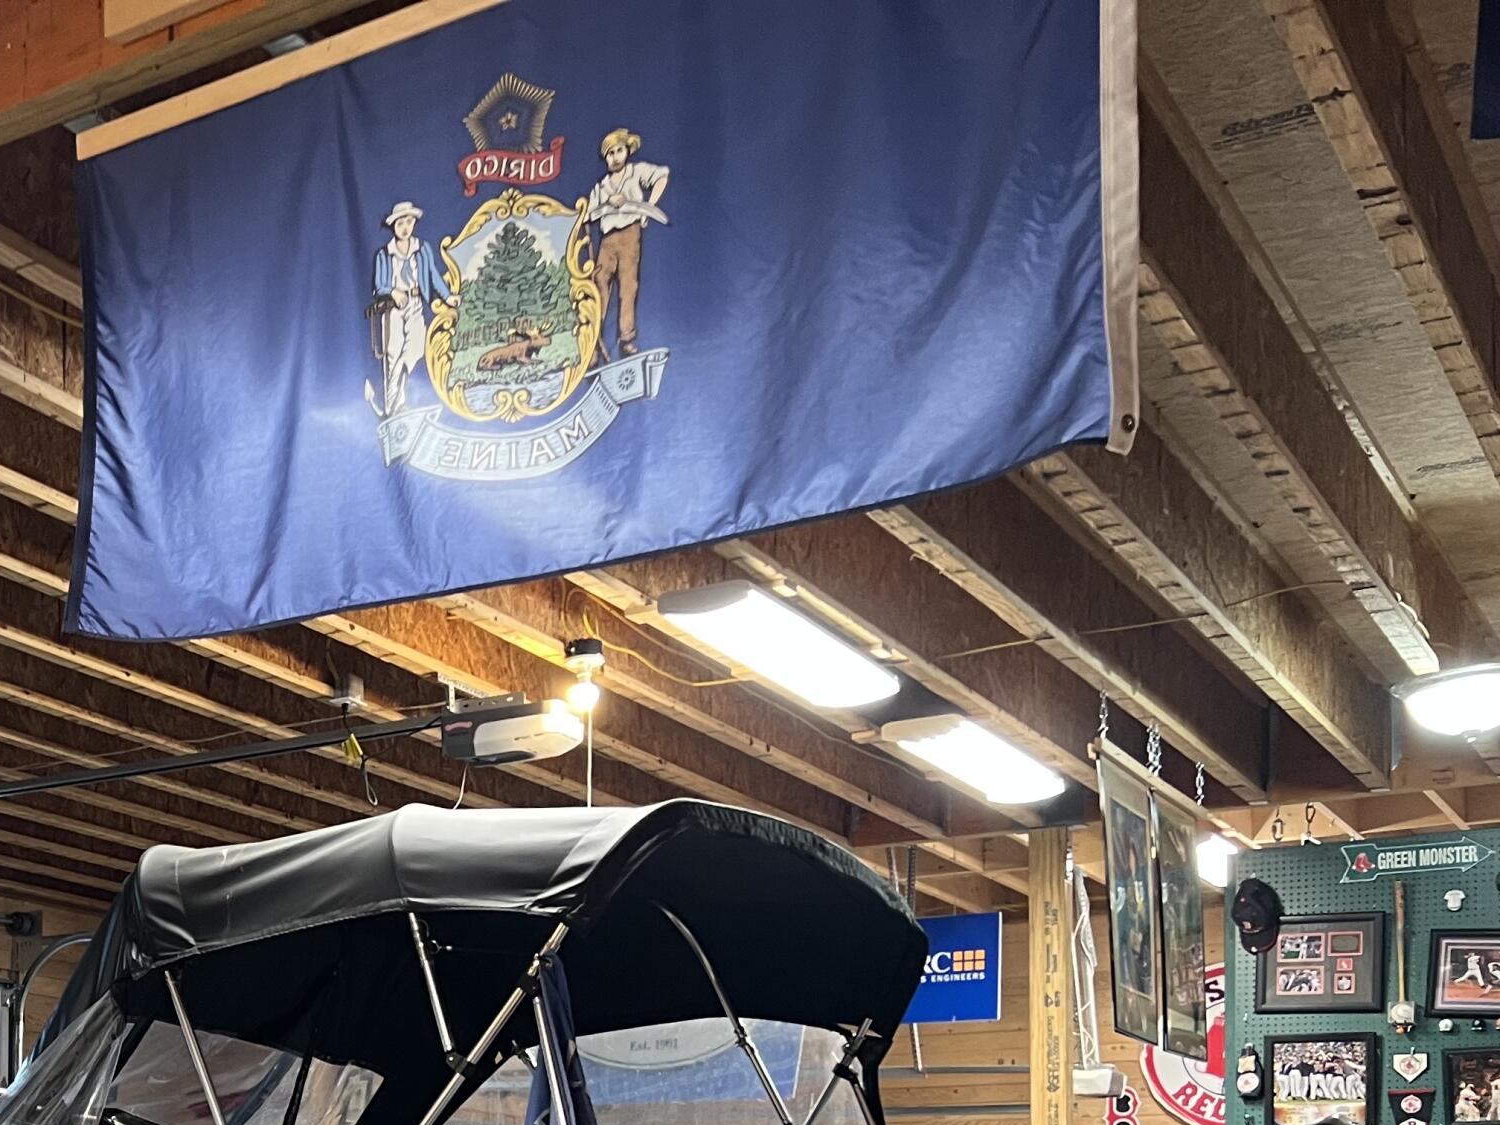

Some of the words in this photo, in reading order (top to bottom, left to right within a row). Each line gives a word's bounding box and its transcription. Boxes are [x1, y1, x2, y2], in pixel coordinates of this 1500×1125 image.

[1377, 850, 1417, 870] GREEN
[1419, 845, 1479, 867] MONSTER
[931, 972, 986, 983] ENGINEERS
